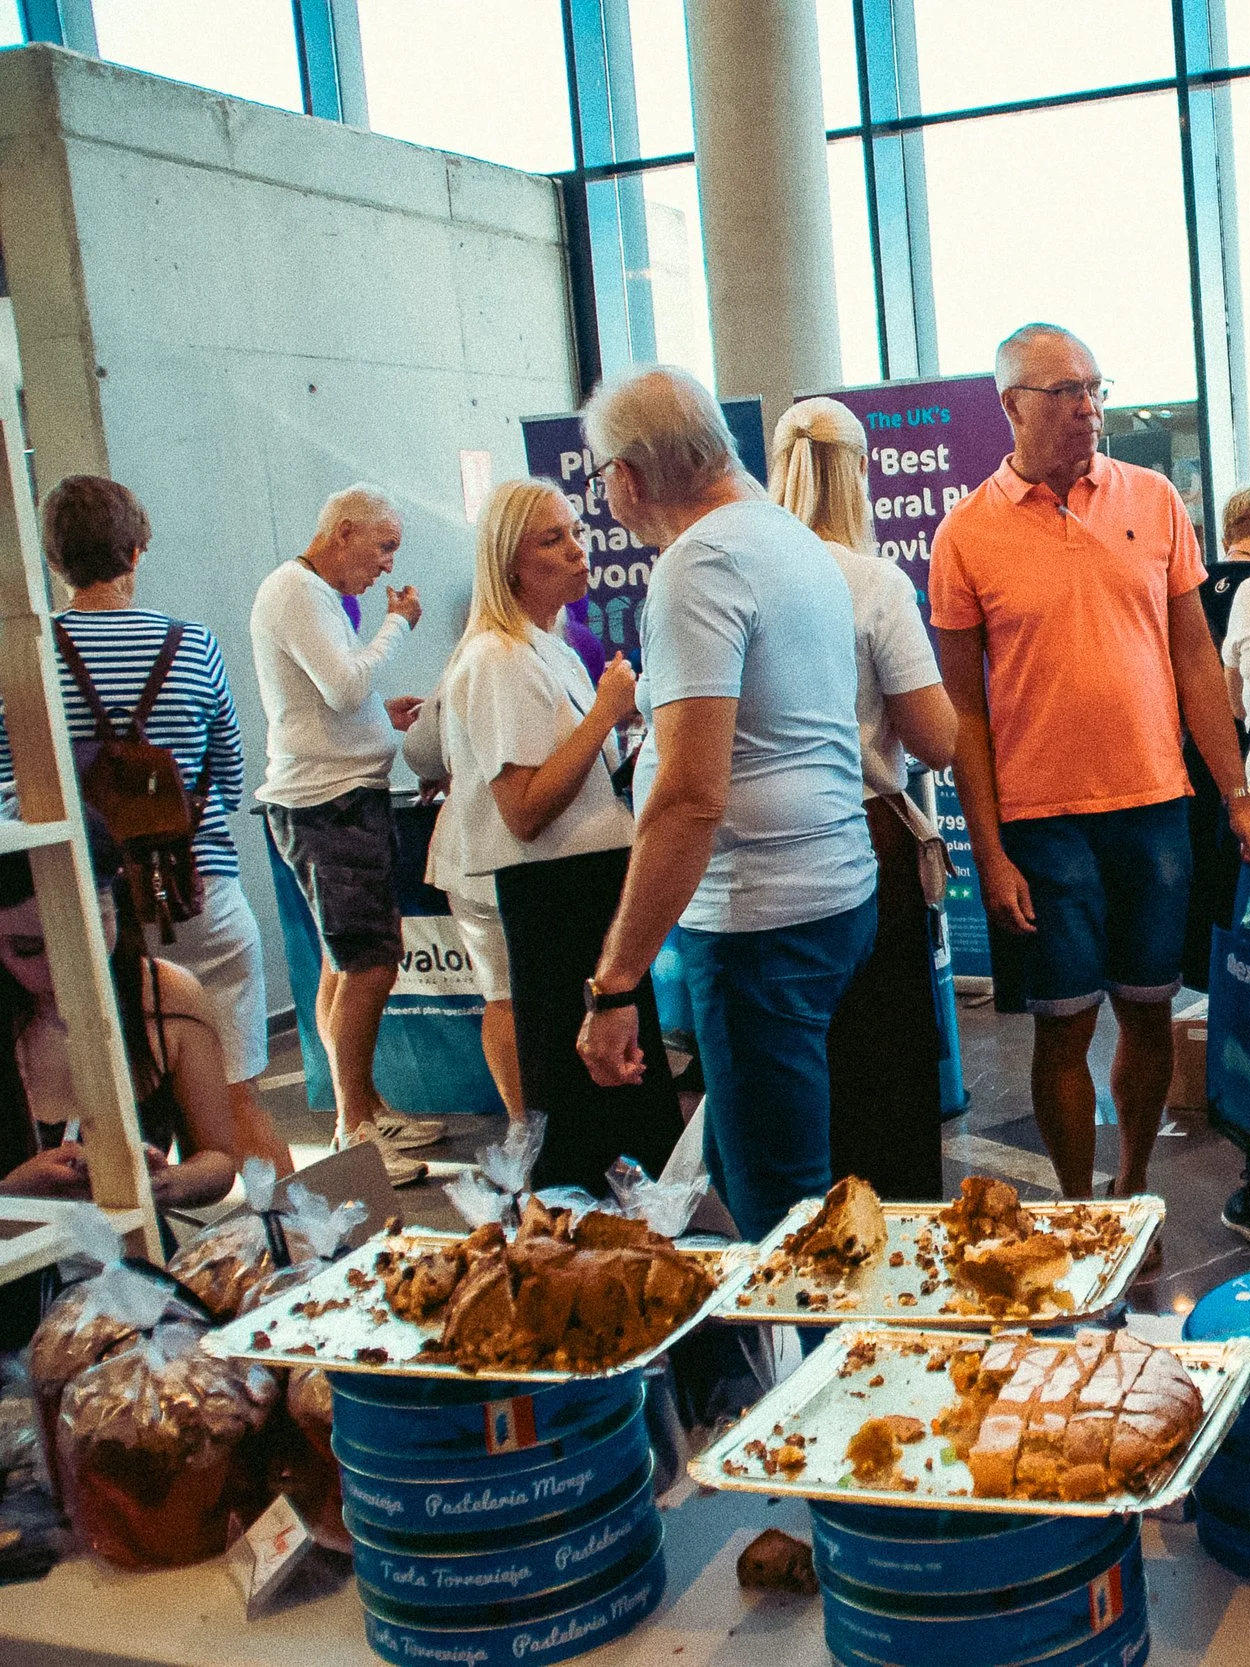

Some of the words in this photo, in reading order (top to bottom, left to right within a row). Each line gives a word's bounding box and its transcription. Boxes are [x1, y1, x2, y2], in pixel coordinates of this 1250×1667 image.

[866, 411, 902, 430] The
[874, 487, 937, 520] eral
[875, 530, 931, 562] ovi
